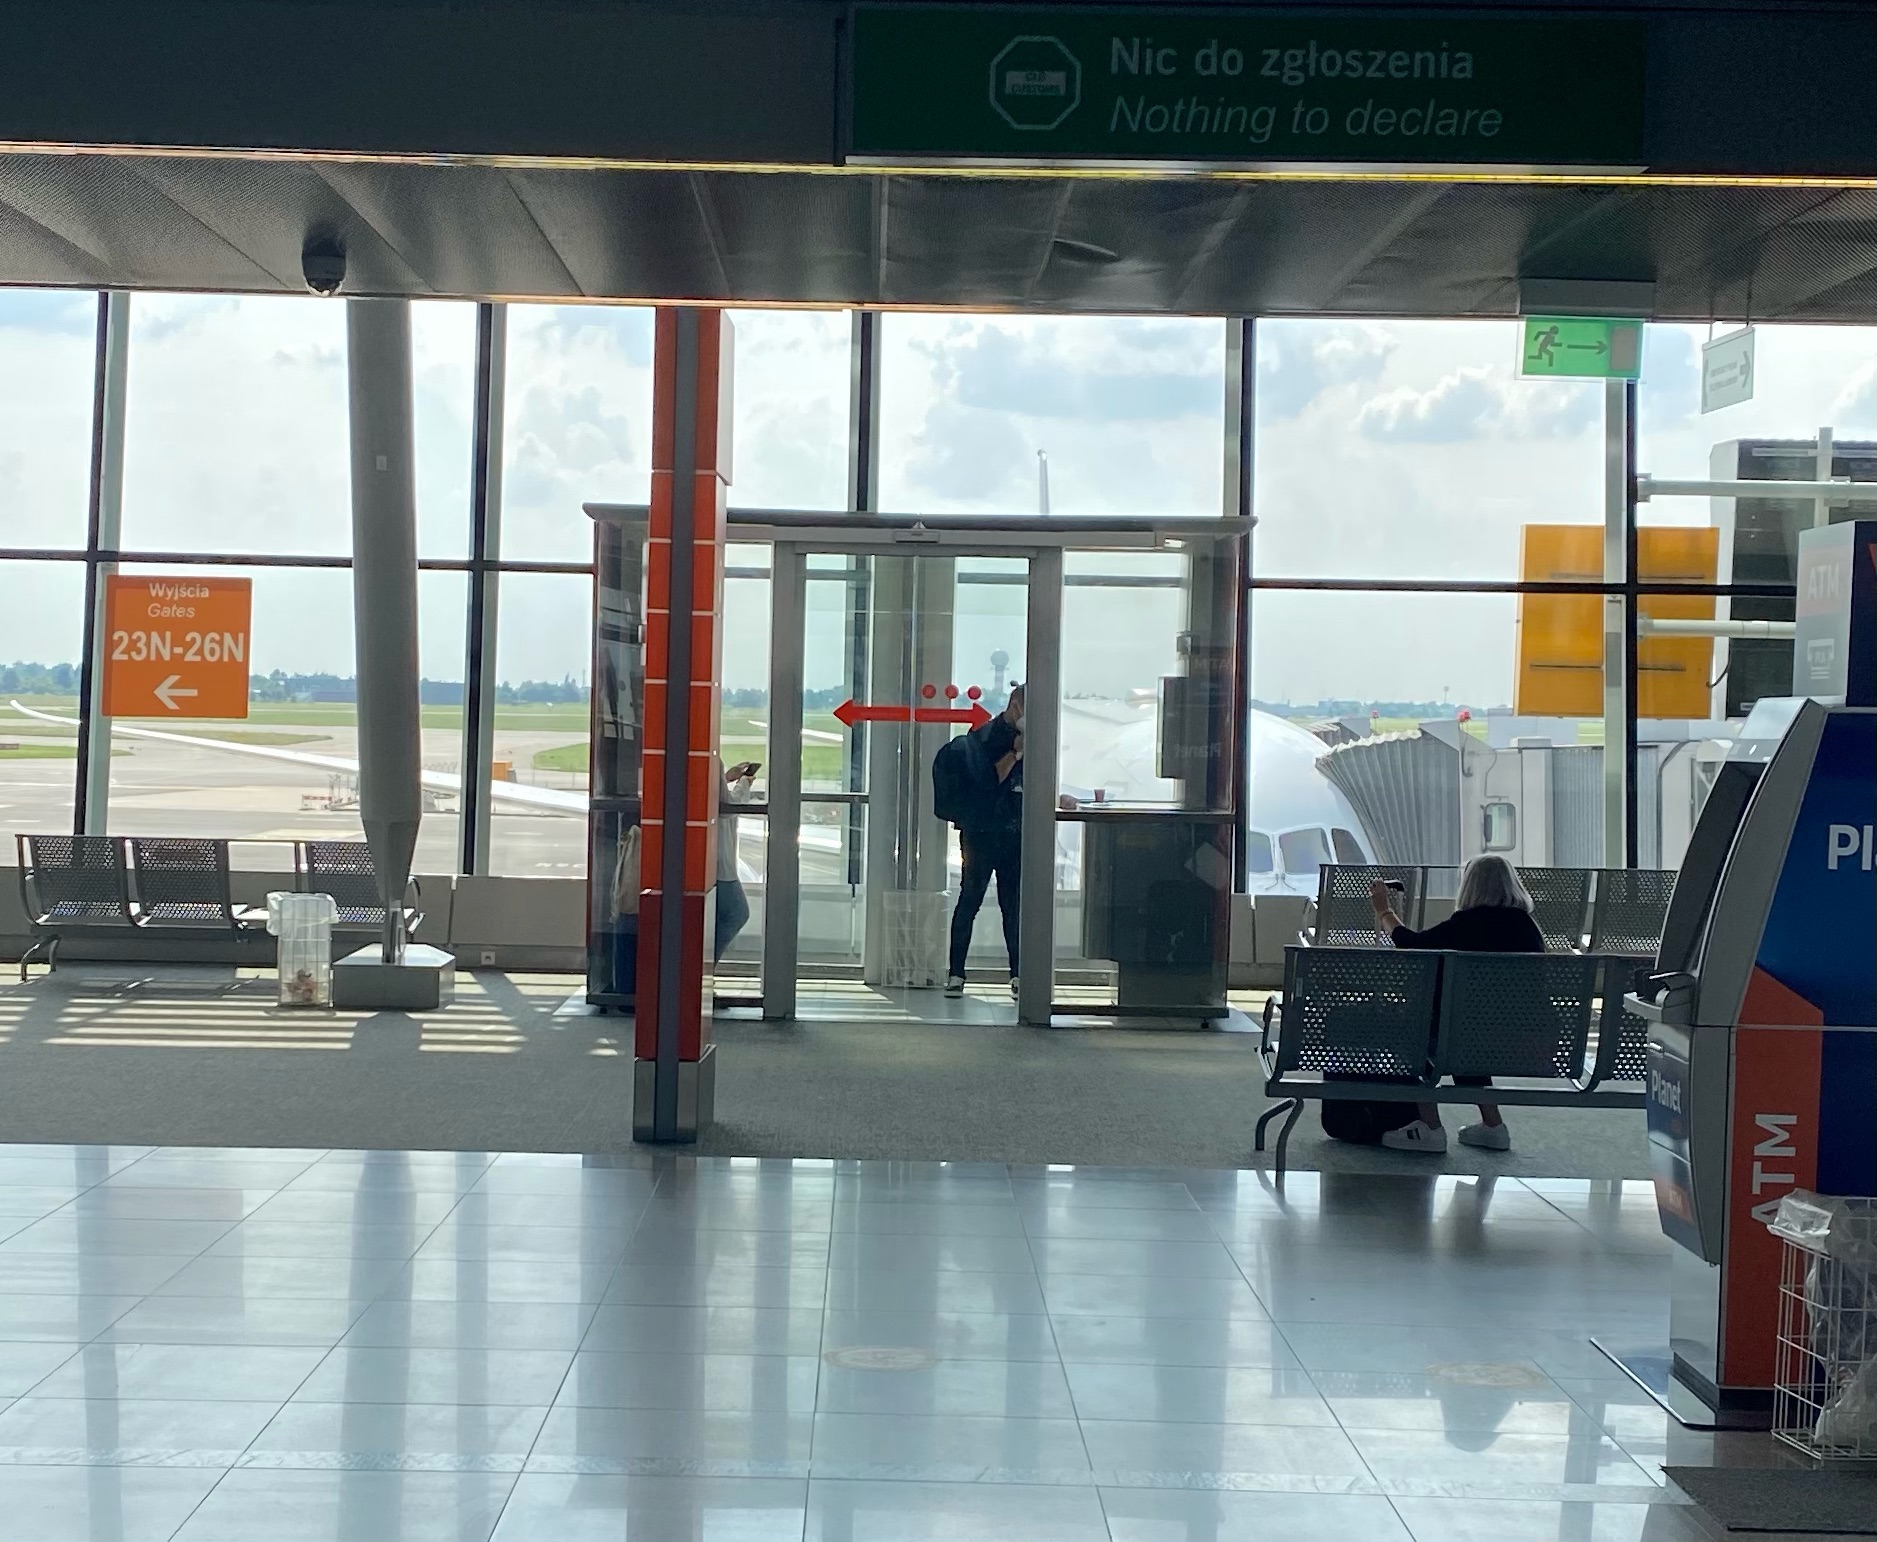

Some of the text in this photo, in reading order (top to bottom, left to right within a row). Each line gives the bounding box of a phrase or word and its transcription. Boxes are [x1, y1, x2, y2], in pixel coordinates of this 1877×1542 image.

[1110, 36, 1473, 86] Nic do zgłoszenia
[1109, 95, 1503, 143] Nothing to declare
[149, 582, 210, 600] Wyjścia
[1807, 562, 1840, 602] ATM
[148, 603, 196, 618] Gates
[112, 630, 244, 662] 23N-26N
[1827, 824, 1877, 871] Pl
[1651, 1069, 1682, 1115] Planet
